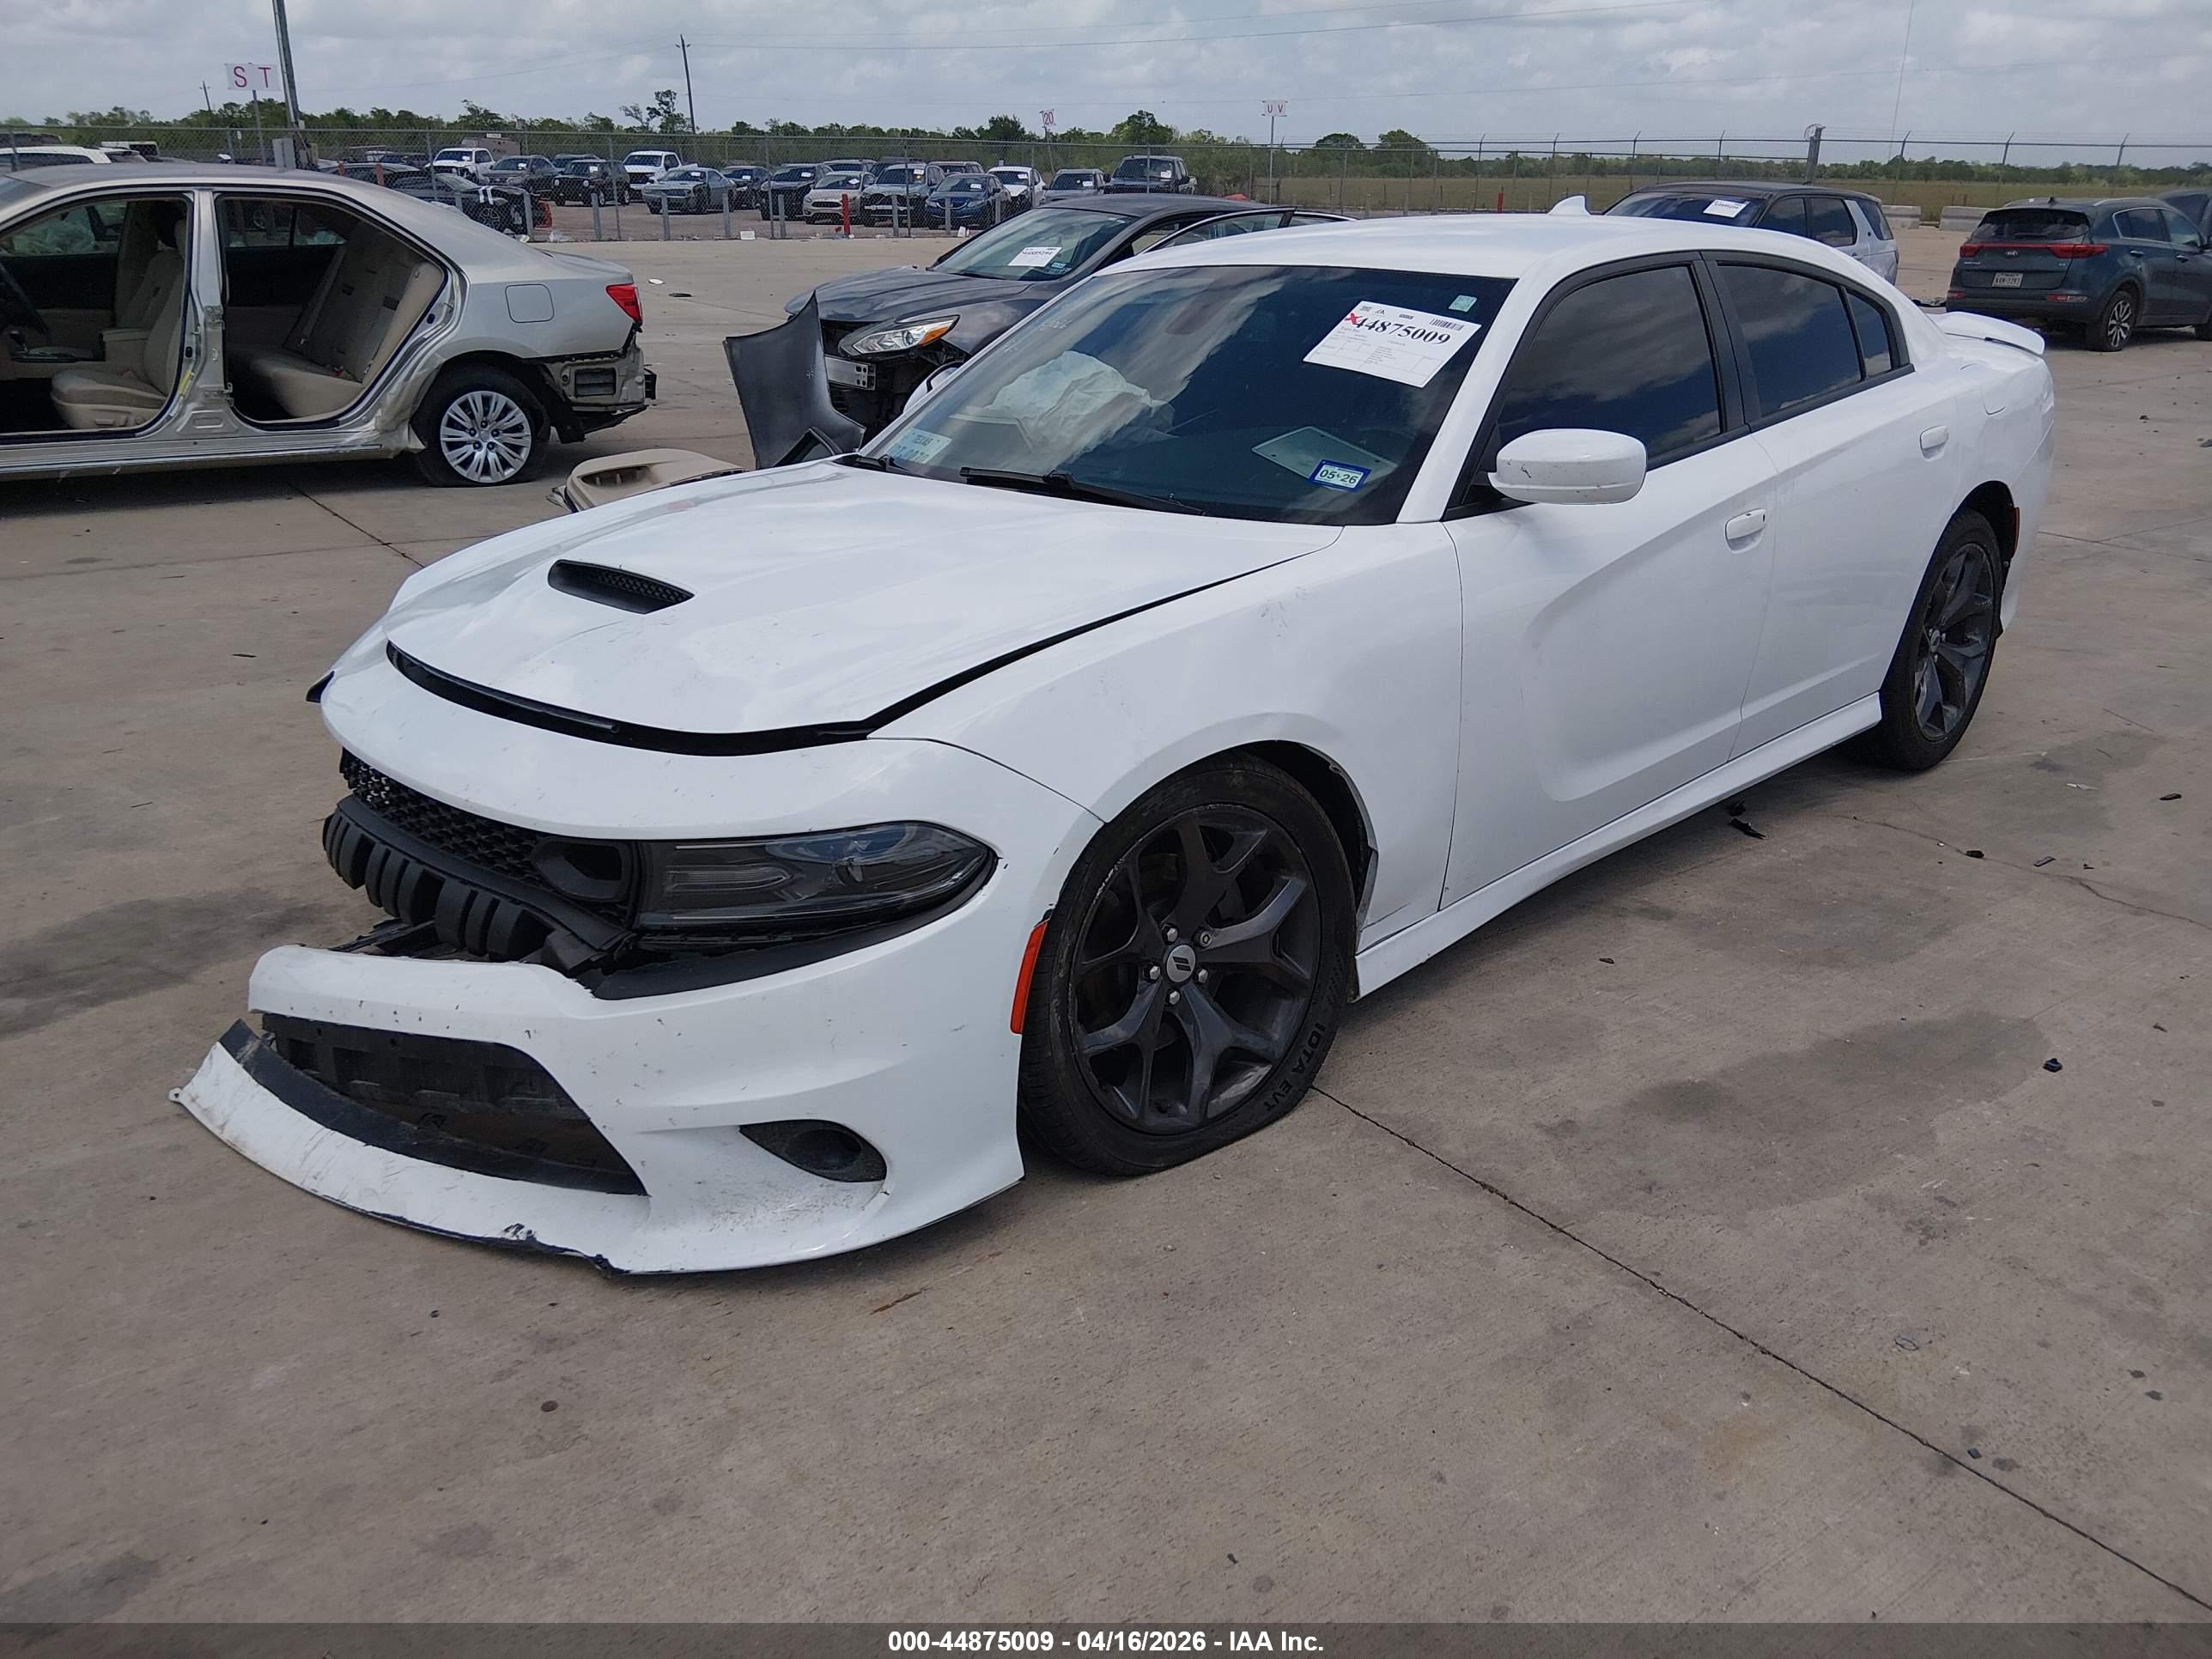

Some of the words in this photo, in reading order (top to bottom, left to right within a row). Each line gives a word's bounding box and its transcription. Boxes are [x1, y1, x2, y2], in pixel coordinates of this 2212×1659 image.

[233, 65, 247, 88] S
[258, 67, 271, 88] T
[1043, 111, 1054, 125] 20
[1267, 104, 1273, 113] U
[1278, 104, 1284, 113] V
[1354, 315, 1452, 345] 44875009
[1319, 469, 1337, 479] 05
[1340, 473, 1358, 484] 26
[1291, 1023, 1326, 1073] IOTA
[1263, 1079, 1292, 1111] EVT
